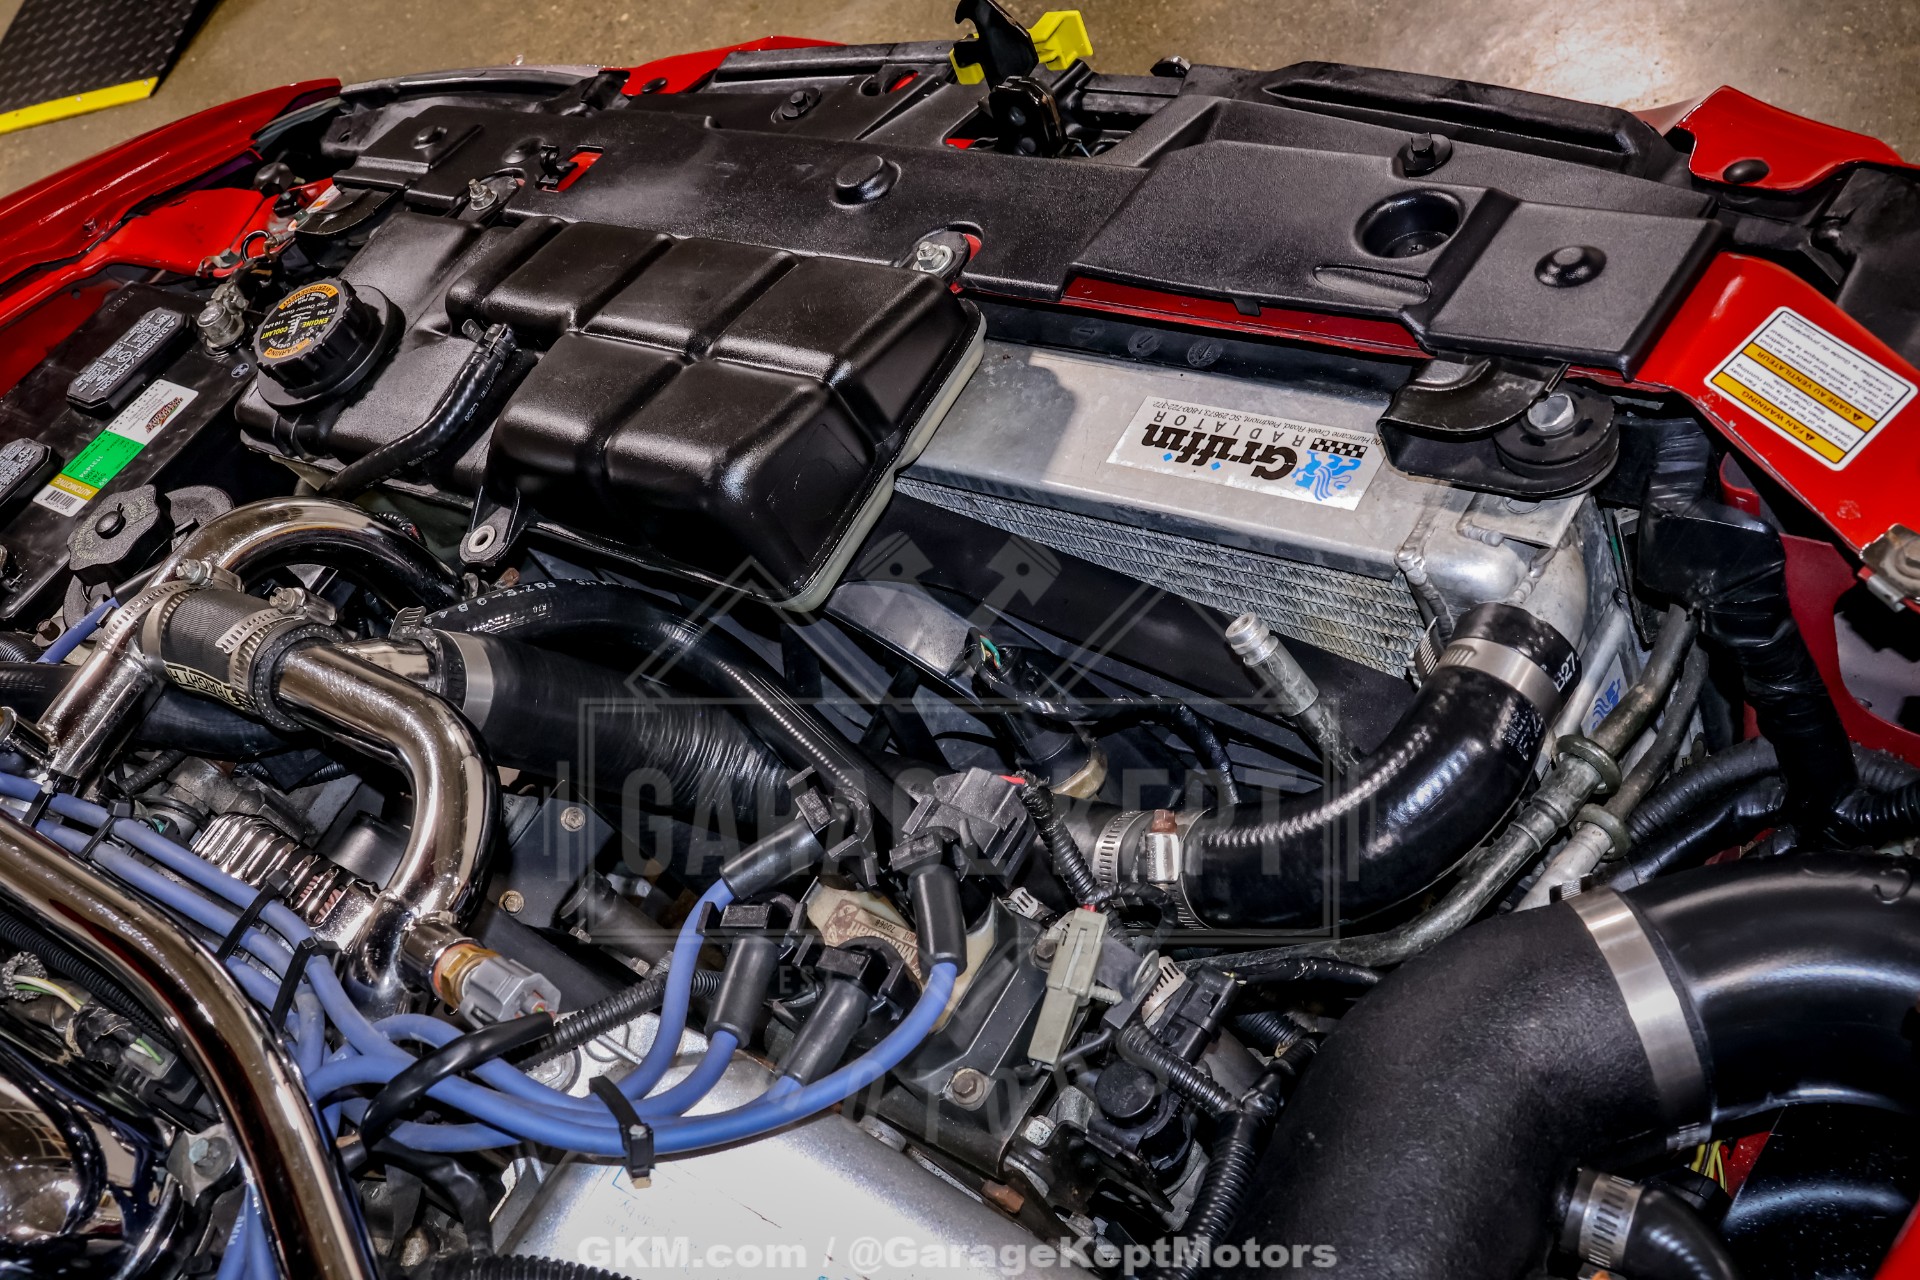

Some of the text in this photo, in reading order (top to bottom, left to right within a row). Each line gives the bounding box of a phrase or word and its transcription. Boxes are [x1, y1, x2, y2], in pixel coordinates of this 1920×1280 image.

[260, 318, 329, 339] ENGINE COOLANT
[1759, 338, 1773, 347] tout
[1764, 333, 1786, 348] mettre
[1769, 328, 1794, 344] moteur
[1796, 353, 1812, 364] peut
[1802, 349, 1829, 367] lorsque
[1830, 350, 1850, 364] Guide
[1782, 353, 1817, 376] ventilateur
[1729, 367, 1744, 377] may
[1812, 364, 1847, 387] ventilateur
[1743, 377, 1757, 386] Fan
[1756, 351, 1852, 413] GARE AU VENTILATEUR
[1762, 381, 1775, 390] not
[1858, 368, 1893, 391] Consulter
[1852, 381, 1879, 398] marche
[1782, 394, 1807, 410] engine
[1792, 392, 1813, 406] Owner
[1740, 391, 1804, 433] FAN WARNING
[1795, 411, 1807, 419] fan
[1806, 410, 1826, 423] when
[1812, 405, 1825, 414] See
[1229, 413, 1241, 421] SC
[1153, 410, 1305, 447] RADIATOR
[1305, 427, 1329, 436] Creek
[1815, 424, 1833, 436] clear
[1826, 422, 1854, 441] operate
[1331, 431, 1370, 443] Hurricane
[1832, 435, 1849, 446] Stay
[1141, 423, 1298, 481] Griffin
[54, 477, 93, 496] AUTOMOTIVE
